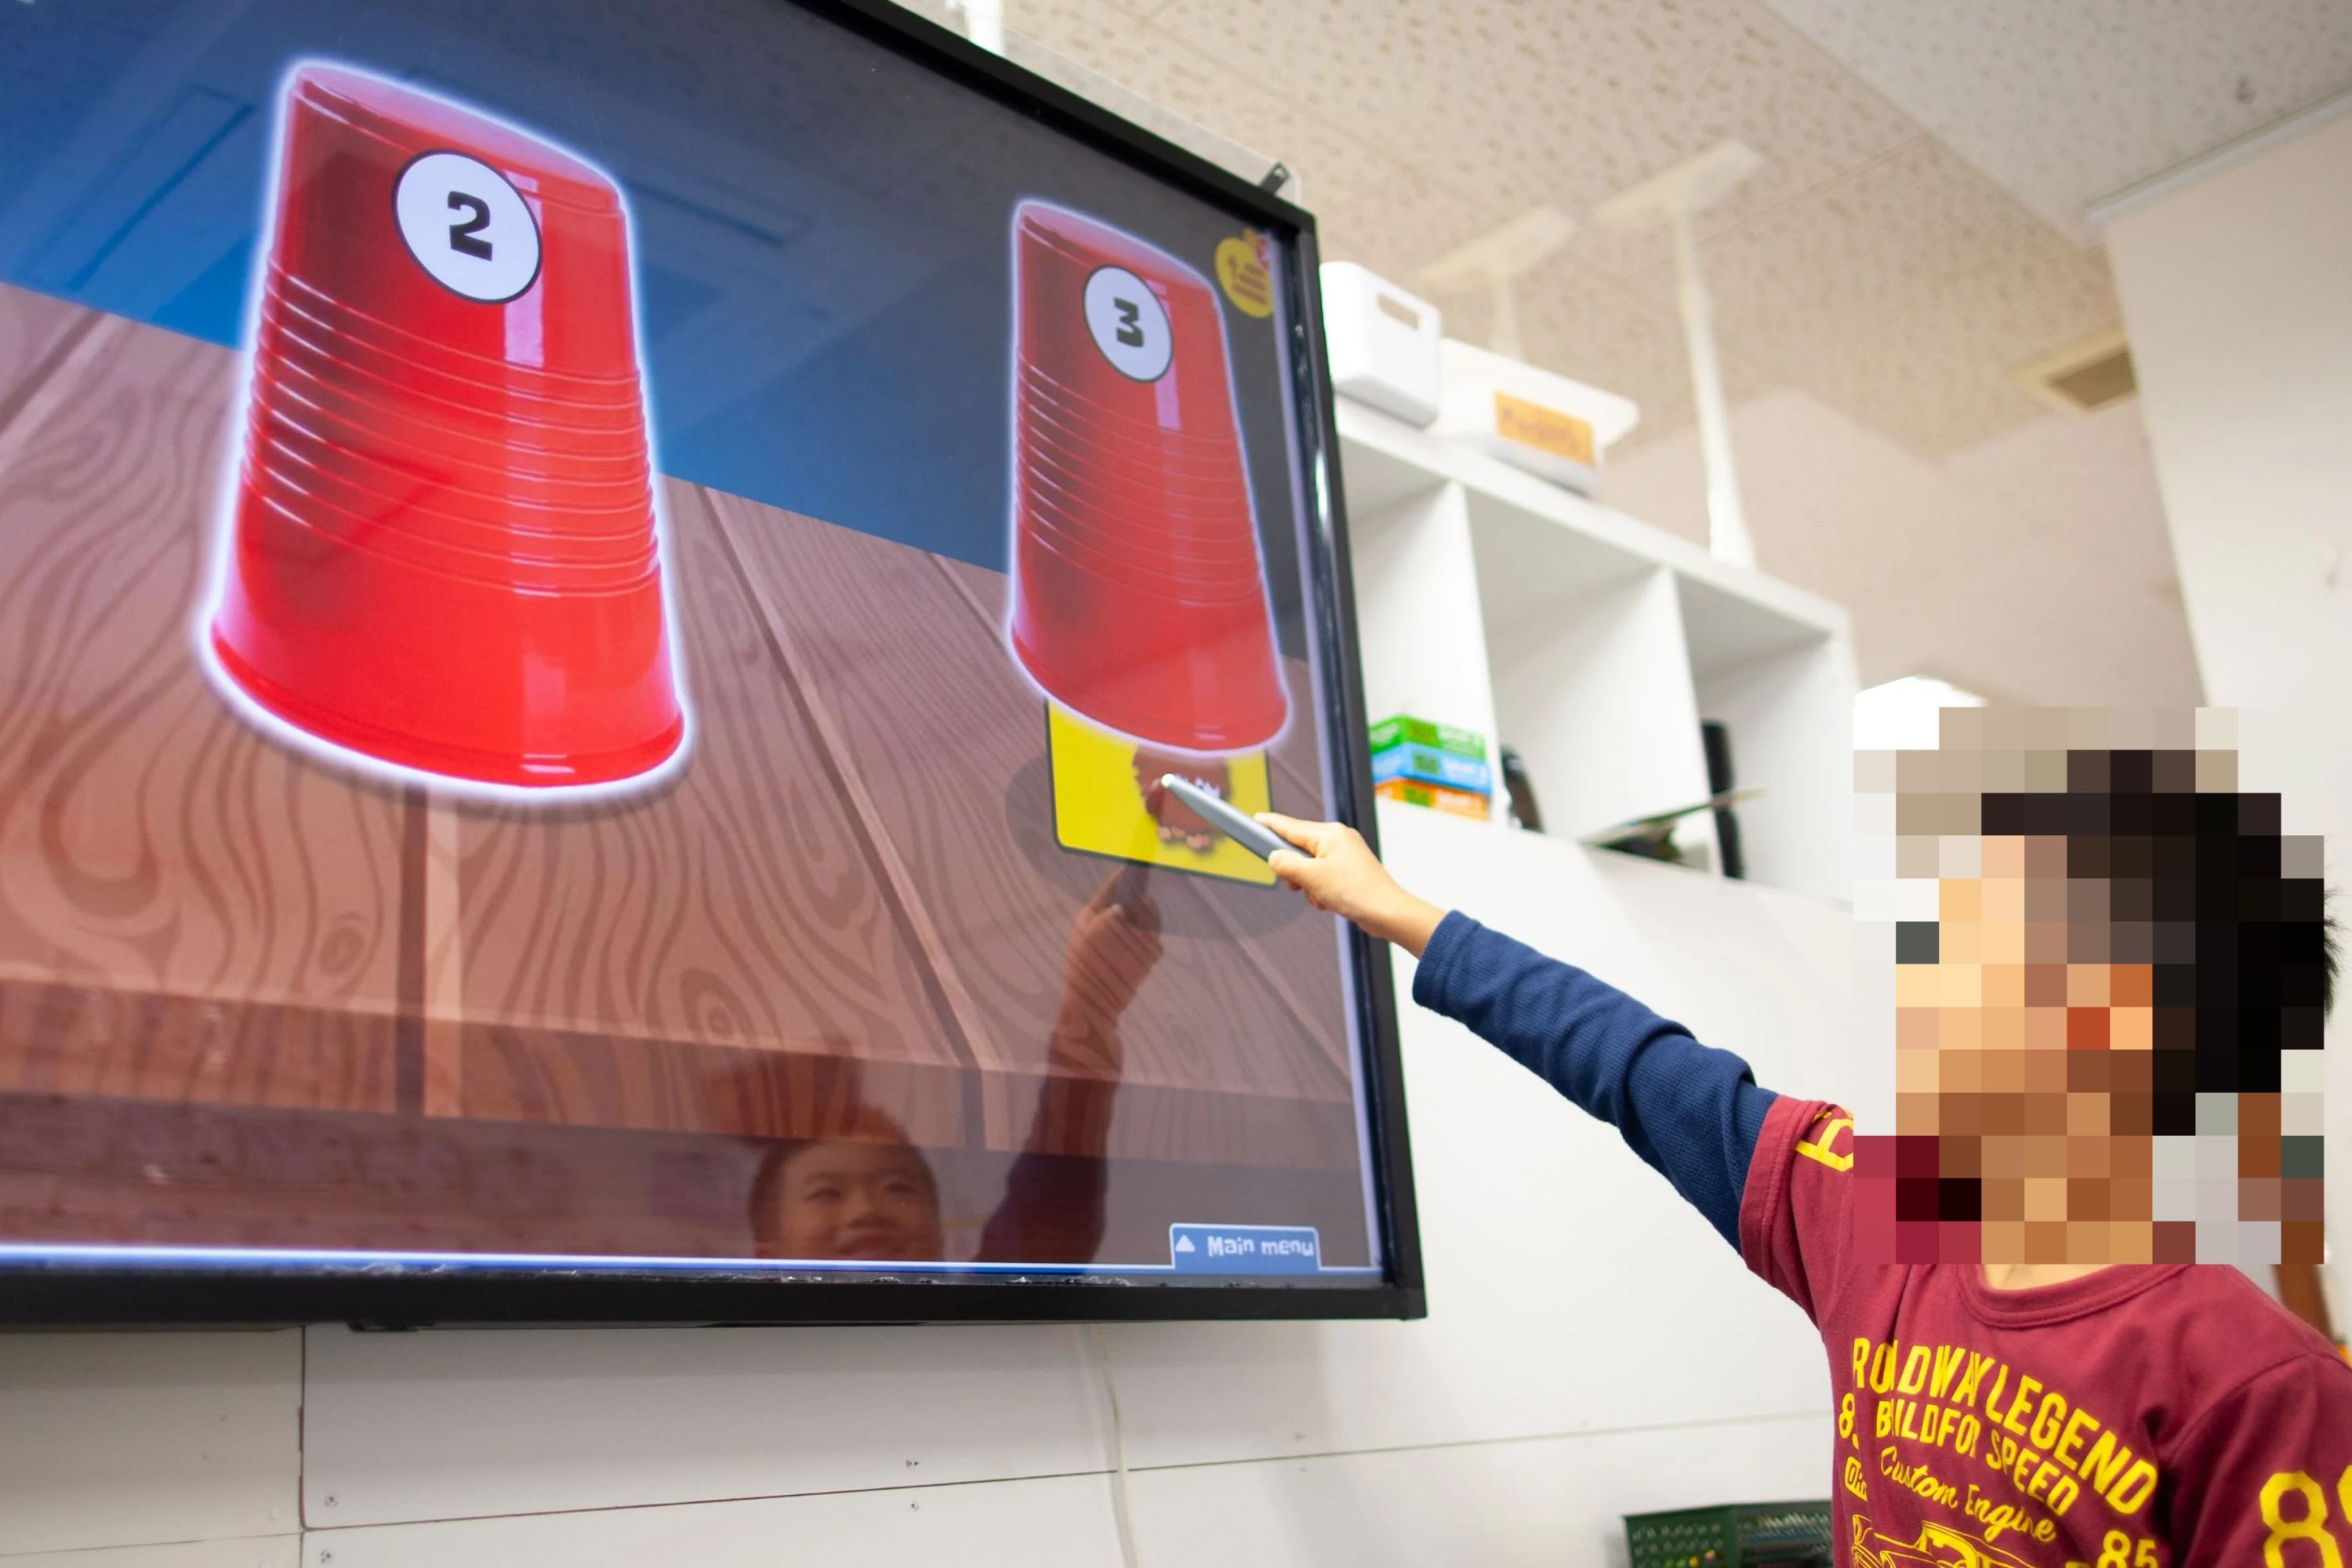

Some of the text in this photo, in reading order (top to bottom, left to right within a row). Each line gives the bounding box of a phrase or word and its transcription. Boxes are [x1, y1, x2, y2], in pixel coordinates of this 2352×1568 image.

[447, 191, 493, 262] 2
[1113, 297, 1145, 348] 3
[1207, 1235, 1315, 1258] Main menu
[1985, 1363, 2159, 1515] LEGEND
[1985, 1428, 2079, 1516] SPEED
[1880, 1445, 1958, 1509] Custom
[1964, 1483, 2057, 1543] Engine
